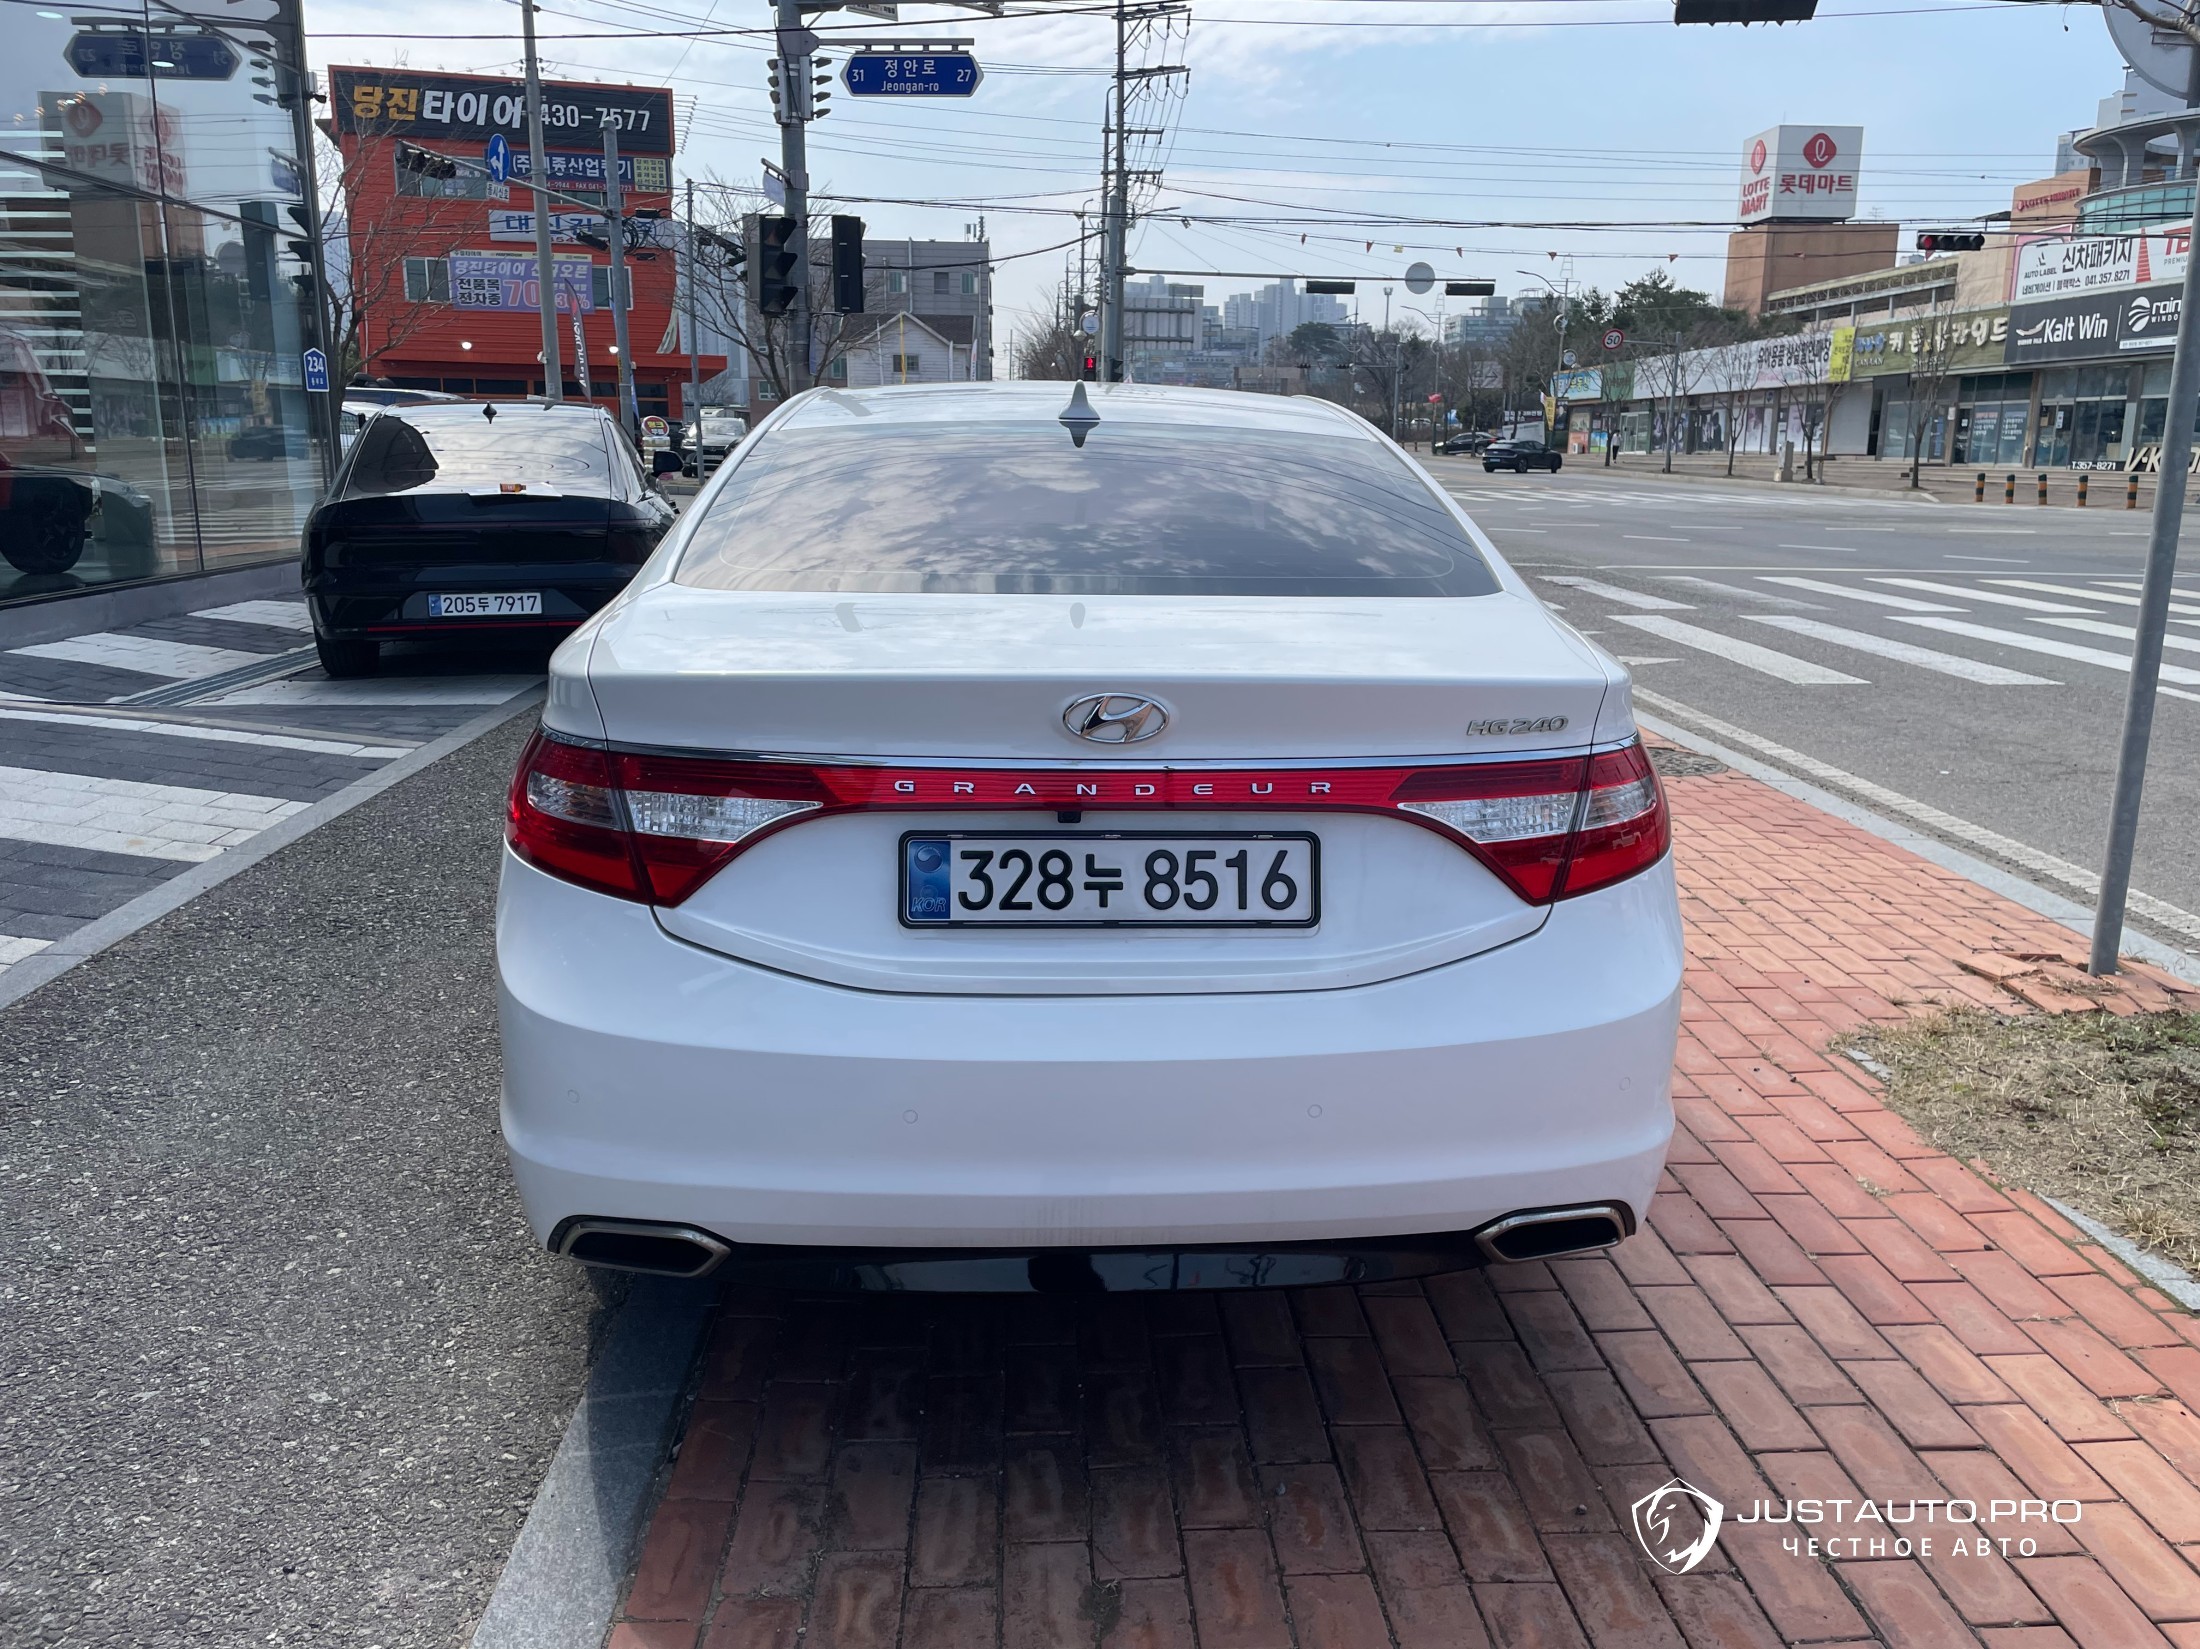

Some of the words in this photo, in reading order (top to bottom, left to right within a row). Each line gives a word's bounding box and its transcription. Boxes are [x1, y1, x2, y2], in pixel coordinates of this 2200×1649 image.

[852, 69, 865, 82] 31
[884, 59, 937, 78] 정안로
[957, 69, 972, 82] 27
[881, 81, 940, 94] Jeongan-ro
[1742, 176, 1770, 198] LOTTE
[1779, 174, 1853, 194] 롯데마트
[1740, 192, 1769, 217] MART
[2062, 238, 2133, 274] 신차패키지
[2164, 255, 2189, 266] PREMIU
[2024, 269, 2039, 279] AUTO
[2040, 267, 2057, 276] LABEL
[2084, 269, 2130, 287] 041.357.8271
[457, 277, 501, 291] 전품목
[457, 292, 501, 306] 전차종
[2151, 313, 2179, 323] WINDO
[2043, 316, 2075, 343] Kalt
[2079, 313, 2109, 340] Win
[1606, 335, 1621, 345] 50
[307, 356, 325, 373] 234
[2072, 461, 2116, 470] T.357-8271
[443, 596, 490, 614] 205두
[494, 595, 538, 612] 7917
[893, 780, 1332, 797] GRANDEUR
[958, 849, 1124, 911] 328누
[1144, 849, 1298, 911] 8516
[911, 897, 946, 912] KOR
